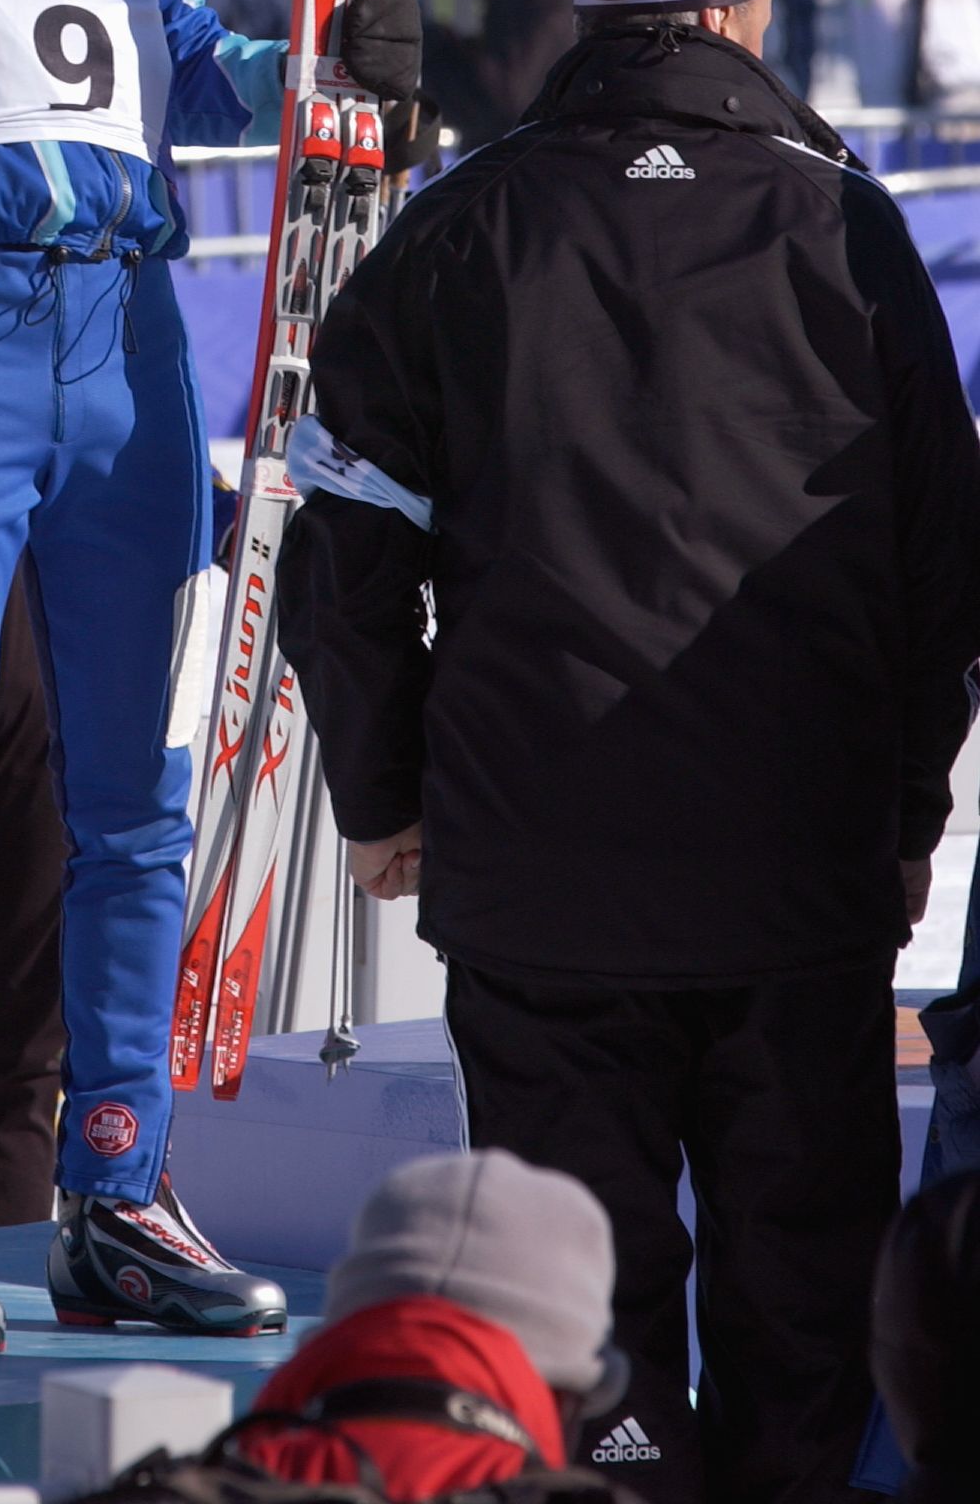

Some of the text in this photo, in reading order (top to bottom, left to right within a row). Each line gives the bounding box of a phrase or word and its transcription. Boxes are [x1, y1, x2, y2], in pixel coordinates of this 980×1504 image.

[33, 4, 114, 112] 9
[625, 163, 696, 180] adidas
[592, 1444, 661, 1463] adidas
